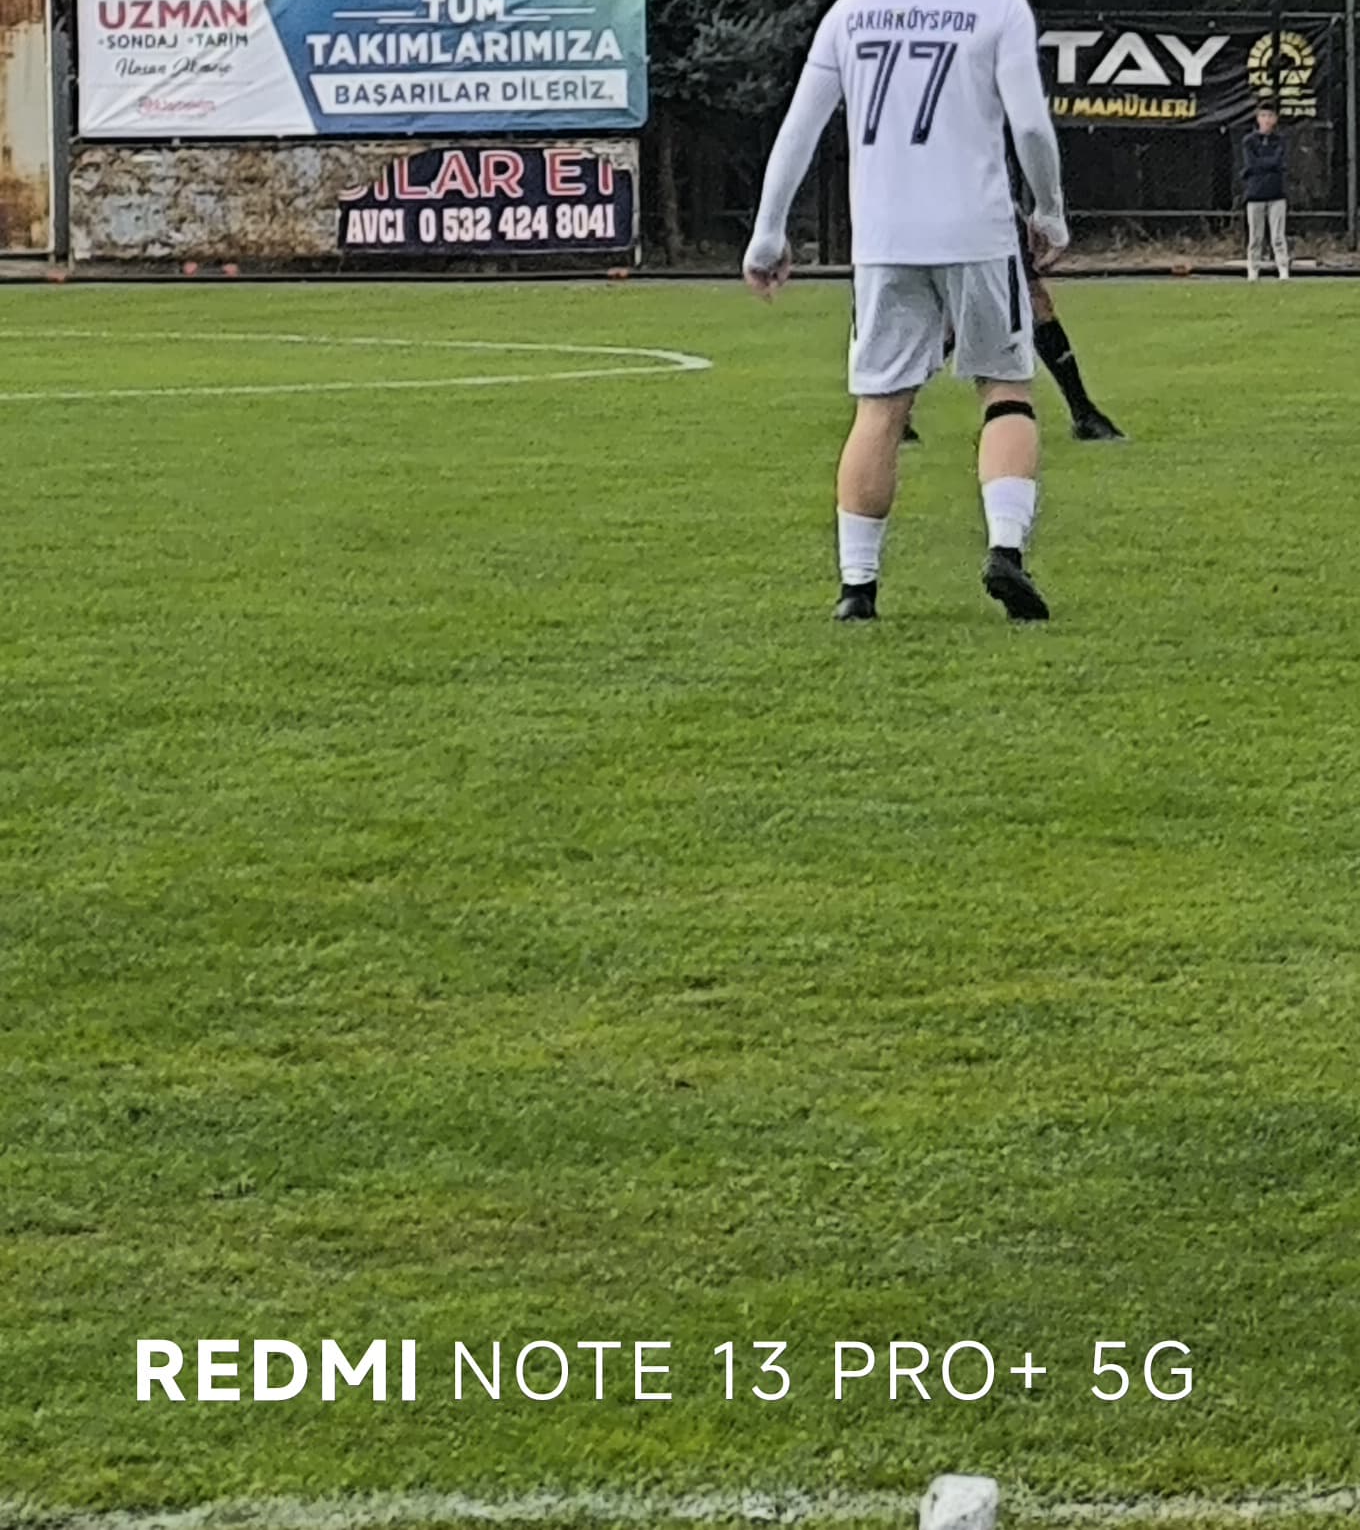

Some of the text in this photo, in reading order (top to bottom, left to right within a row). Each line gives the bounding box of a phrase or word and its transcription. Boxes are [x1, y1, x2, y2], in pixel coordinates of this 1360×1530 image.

[98, 0, 248, 29] UZMAN
[106, 34, 178, 49] SONDAJ
[307, 29, 623, 66] TAKIMLARIMIZA
[1039, 31, 1230, 86] TAY
[335, 82, 490, 107] BAŞARILAR
[855, 40, 958, 145] 77
[346, 203, 615, 243] AVCI 0 532 424 8041
